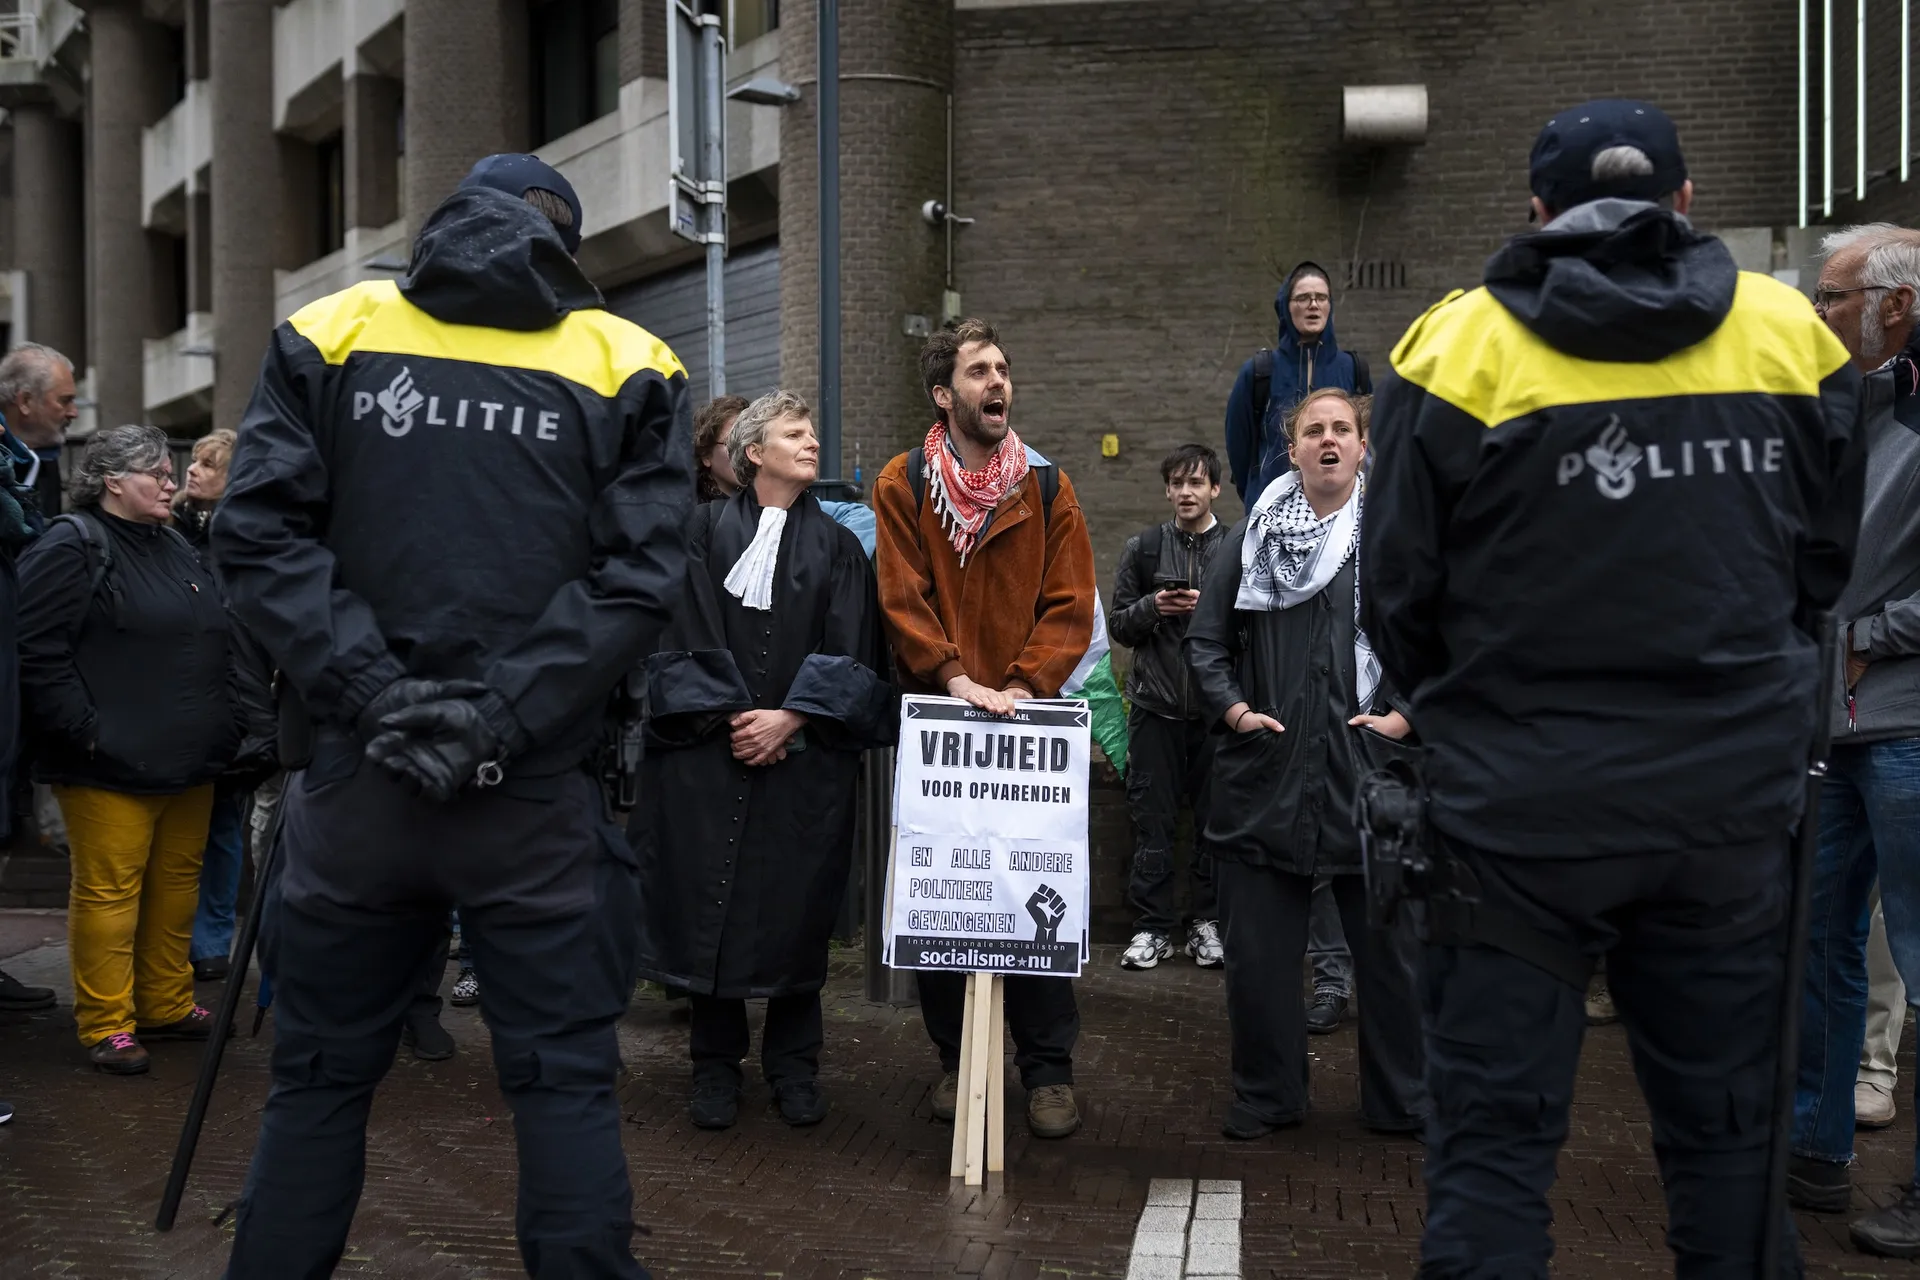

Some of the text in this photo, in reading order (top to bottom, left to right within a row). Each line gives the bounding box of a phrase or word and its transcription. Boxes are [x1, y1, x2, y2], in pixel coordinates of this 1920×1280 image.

[920, 730, 1071, 773] VRIJHEID
[921, 779, 1071, 804] VOOR OPVARENDEN
[911, 846, 1073, 873] EN ALLE ANDERE
[909, 878, 993, 901] POLITIEKE
[908, 909, 1016, 933] GEVANGENEN
[907, 938, 1066, 951] Internationale Socialisten
